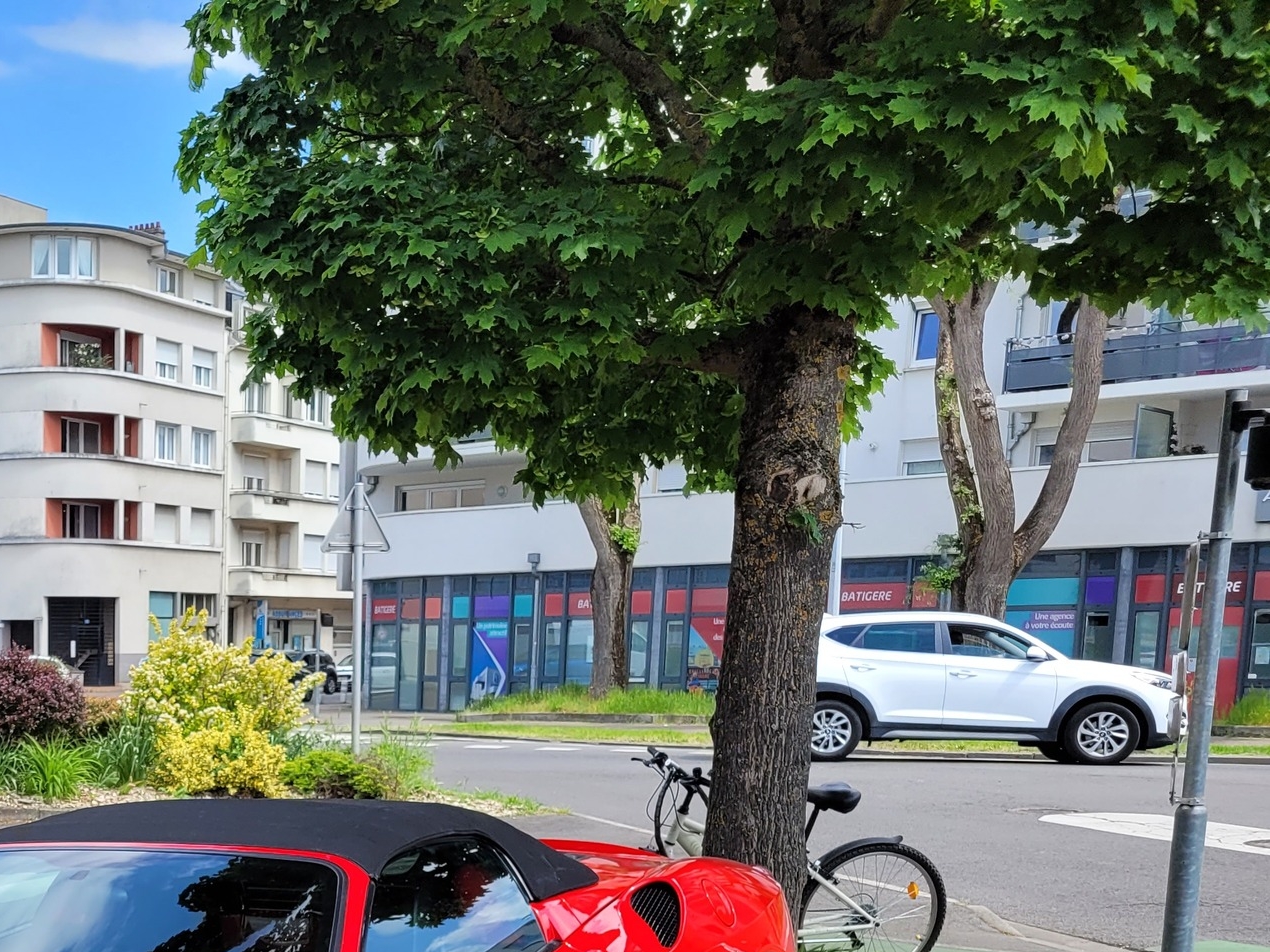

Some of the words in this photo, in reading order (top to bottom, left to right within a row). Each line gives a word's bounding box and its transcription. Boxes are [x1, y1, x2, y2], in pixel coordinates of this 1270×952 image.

[841, 591, 892, 602] BATIGERE
[1035, 612, 1049, 620] Une
[1050, 613, 1075, 622] agence
[1050, 621, 1074, 629] écoute
